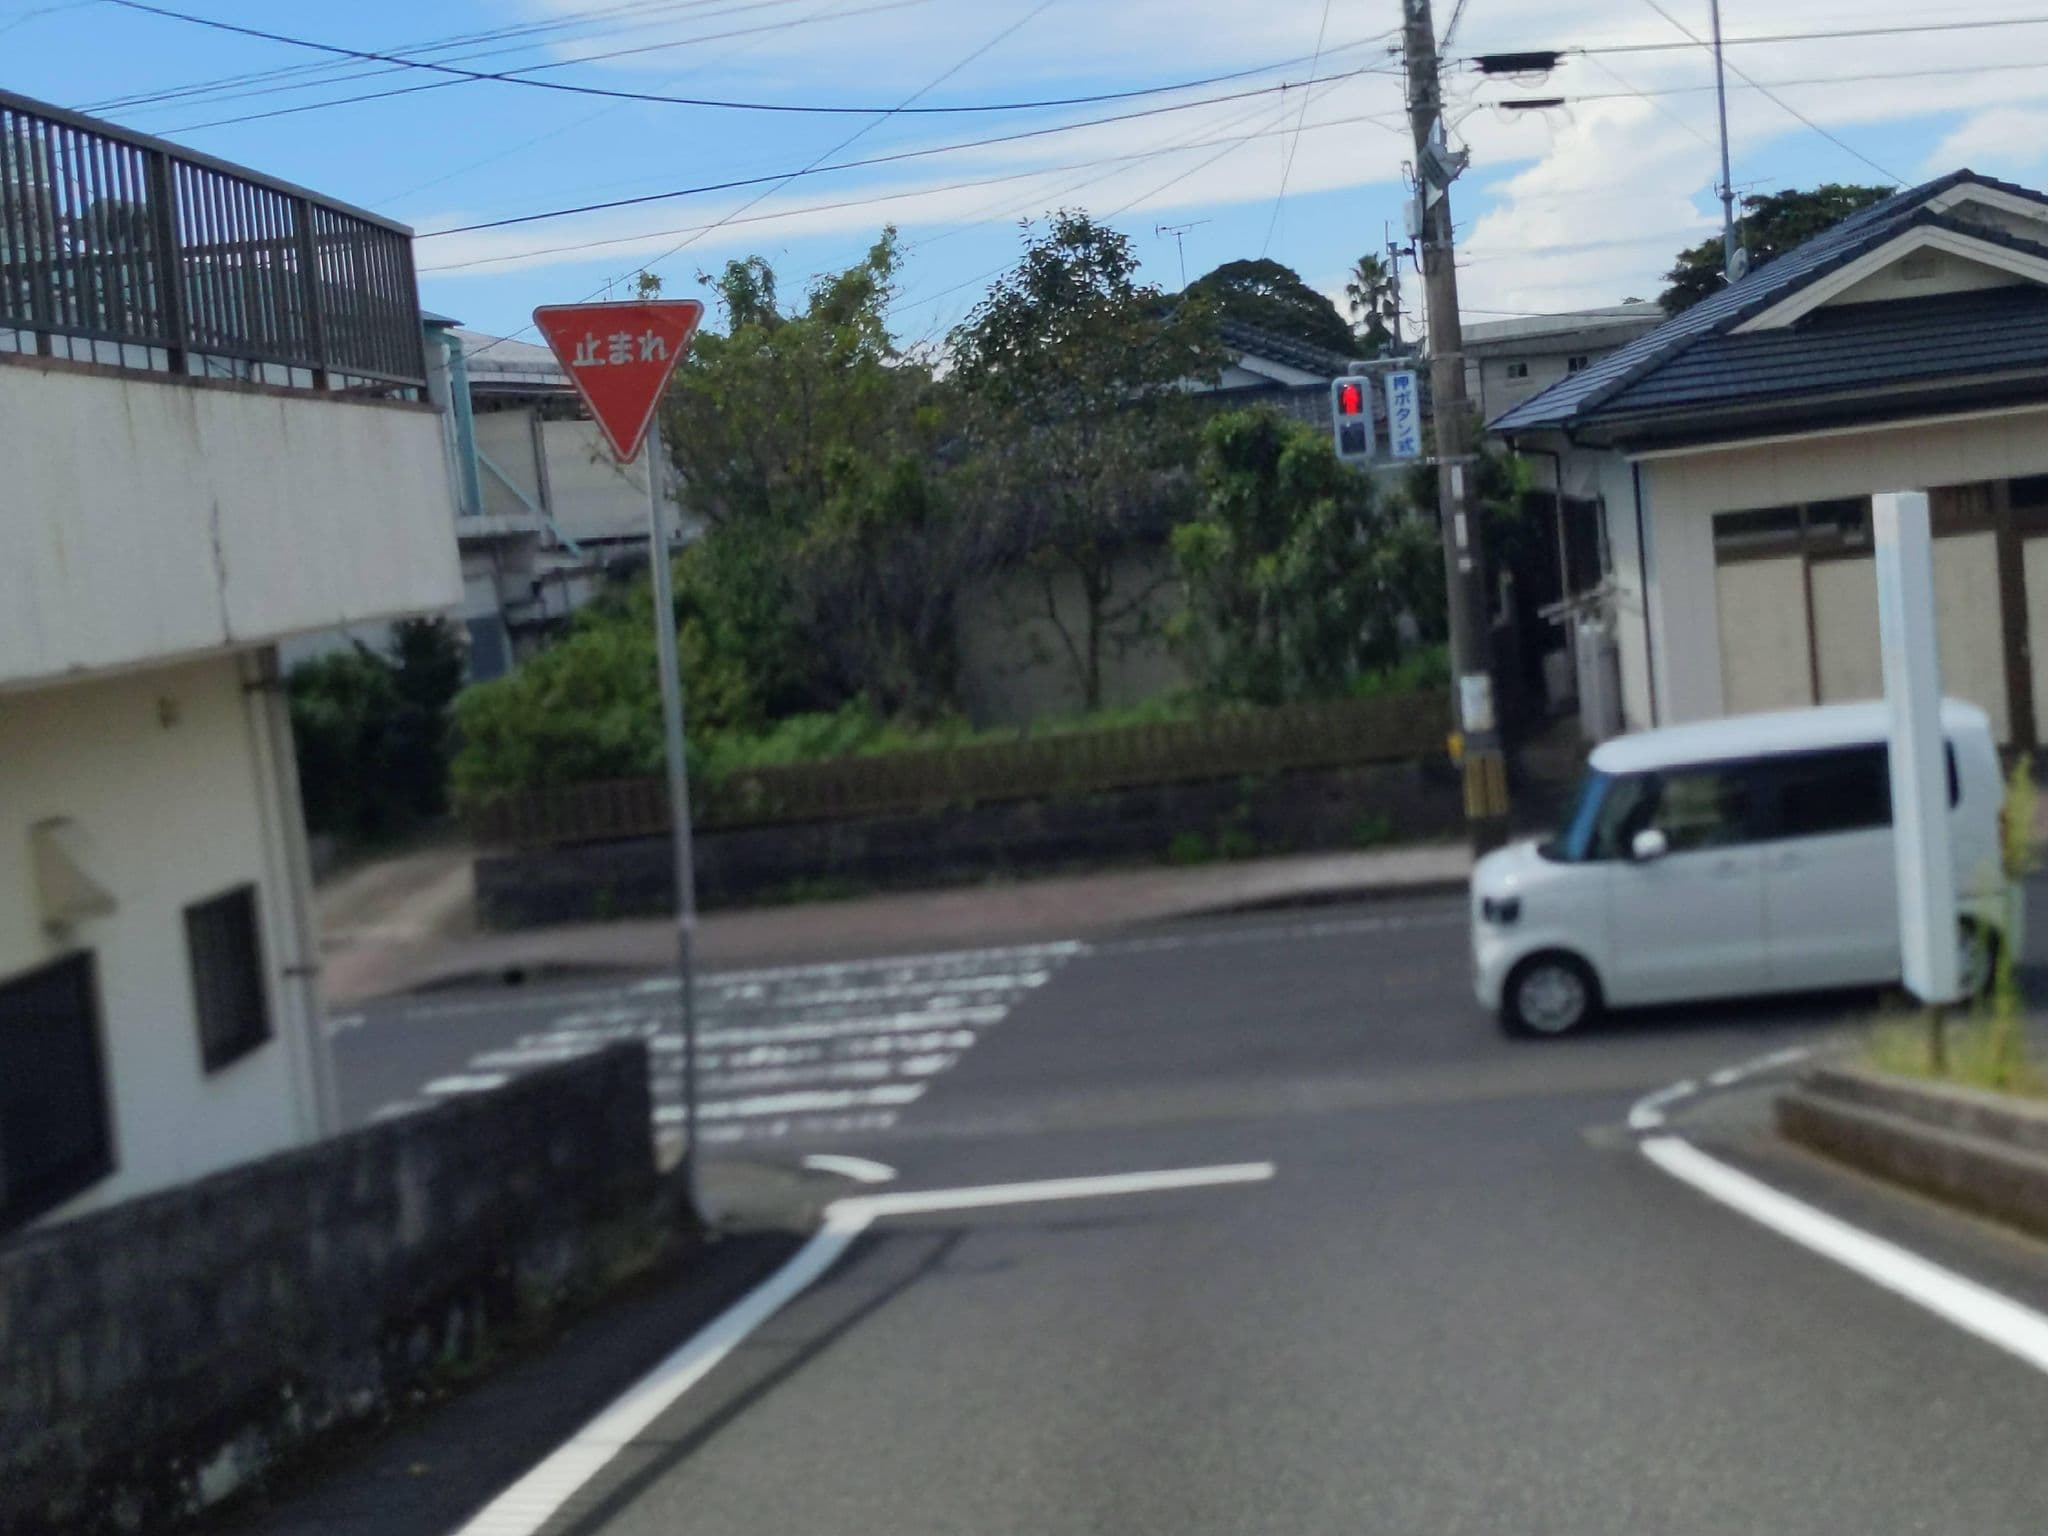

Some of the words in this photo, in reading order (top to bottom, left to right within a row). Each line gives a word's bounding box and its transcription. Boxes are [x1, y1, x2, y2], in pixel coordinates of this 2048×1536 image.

[572, 329, 669, 366] 止まれ
[1392, 376, 1415, 454] 押ボタン式
